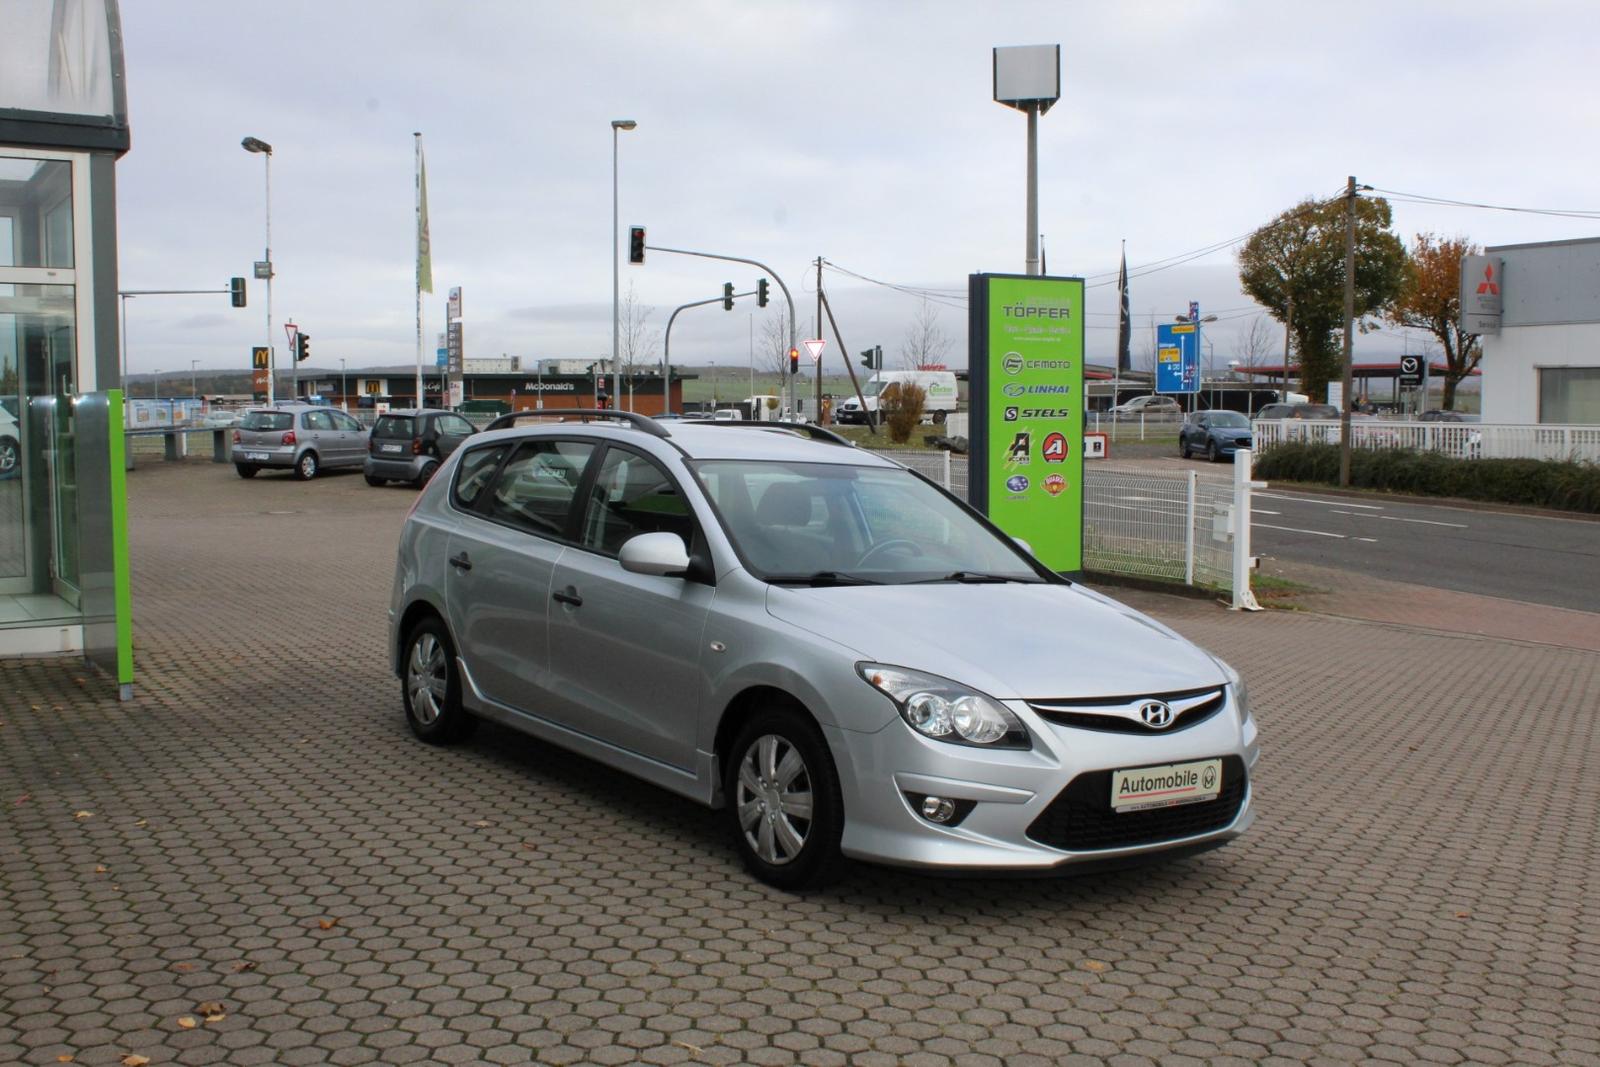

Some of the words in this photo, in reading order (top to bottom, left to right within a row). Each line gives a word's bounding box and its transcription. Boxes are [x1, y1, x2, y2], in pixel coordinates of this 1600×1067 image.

[1002, 301, 1070, 319] TÖPFER
[1026, 360, 1071, 369] CFMOTO
[525, 382, 575, 391] McDonald's
[1027, 385, 1070, 394] LINHAI
[1021, 408, 1069, 418] STELS
[1119, 770, 1198, 794] Automobile
